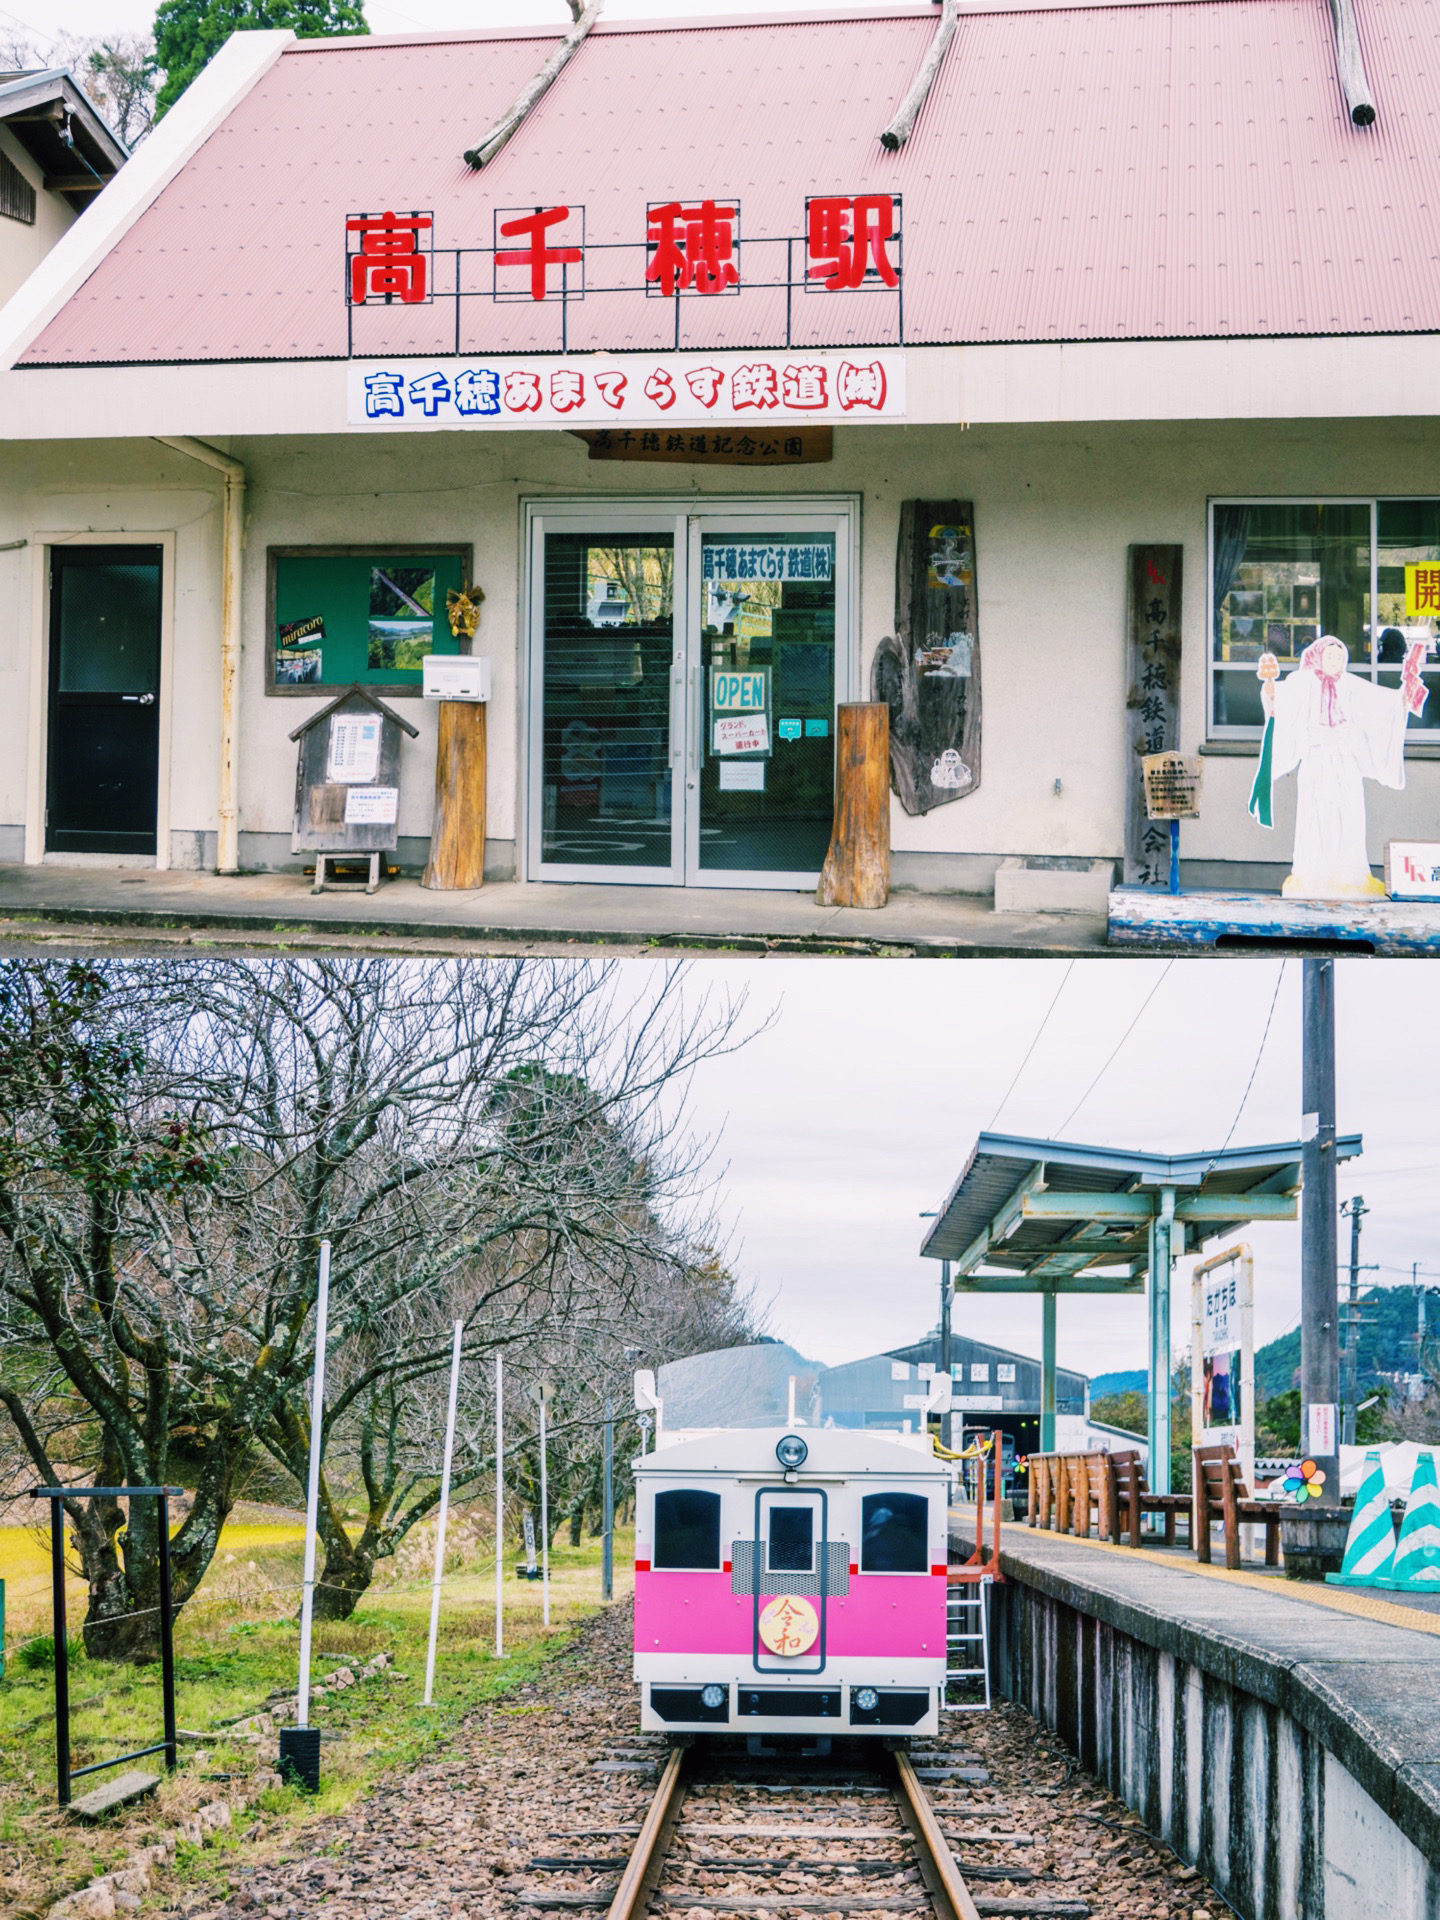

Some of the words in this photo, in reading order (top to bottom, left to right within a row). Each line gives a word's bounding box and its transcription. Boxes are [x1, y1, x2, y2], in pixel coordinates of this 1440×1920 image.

[346, 194, 900, 305] 高千穂駅
[282, 616, 323, 646] miracoro
[716, 676, 763, 706] OPEN
[1138, 597, 1171, 886] 高千穂鉄道会社
[1398, 855, 1426, 882] TR
[1206, 1281, 1236, 1318] たかちほ
[641, 1416, 648, 1426] 2
[773, 1598, 805, 1653] 令和
